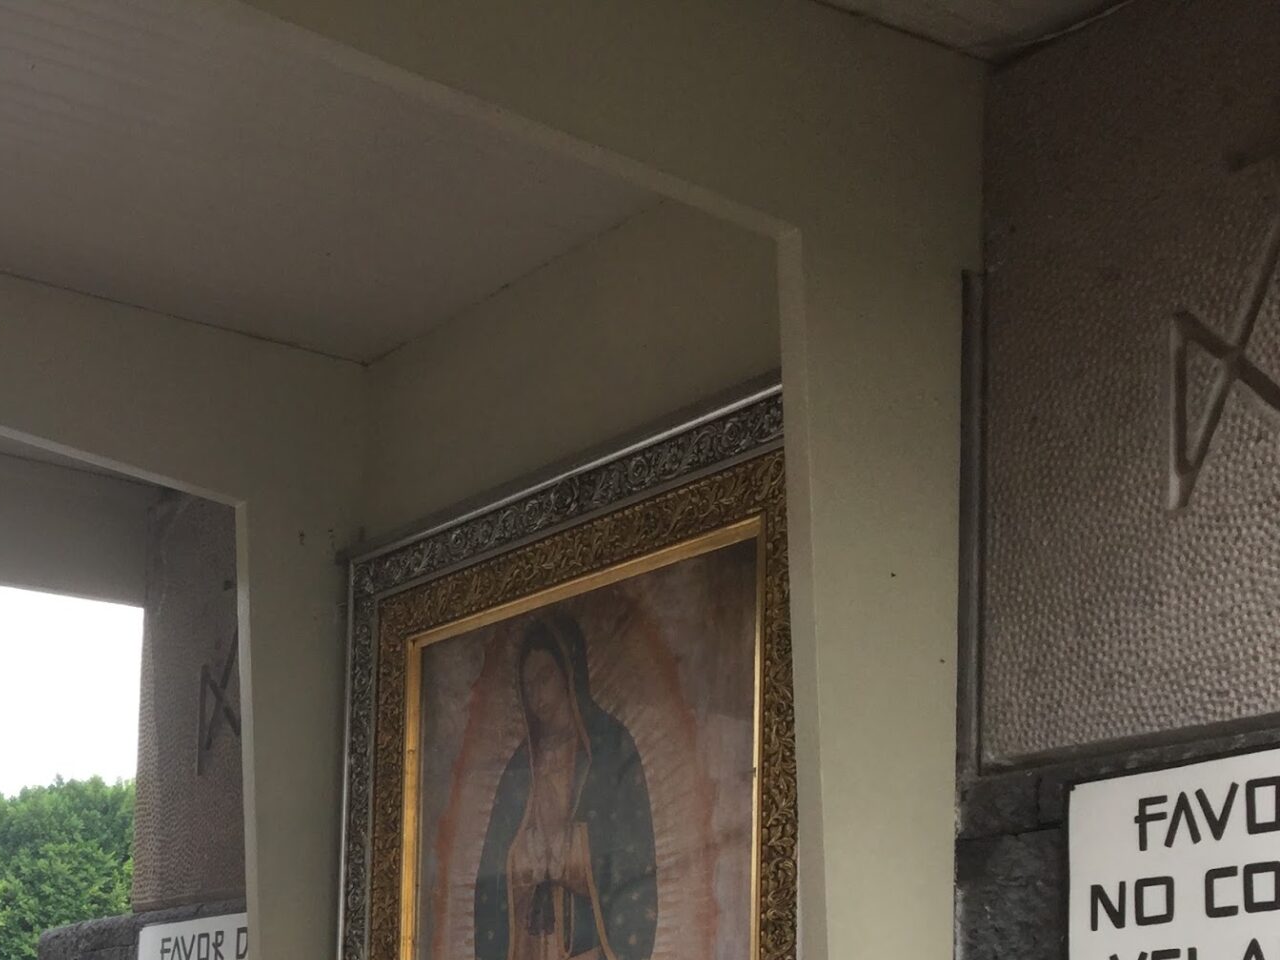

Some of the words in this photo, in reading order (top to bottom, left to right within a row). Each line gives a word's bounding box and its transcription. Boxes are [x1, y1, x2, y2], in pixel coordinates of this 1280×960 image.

[1134, 775, 1280, 851] FAVO
[1090, 876, 1174, 931] NO
[1205, 861, 1280, 918] CO
